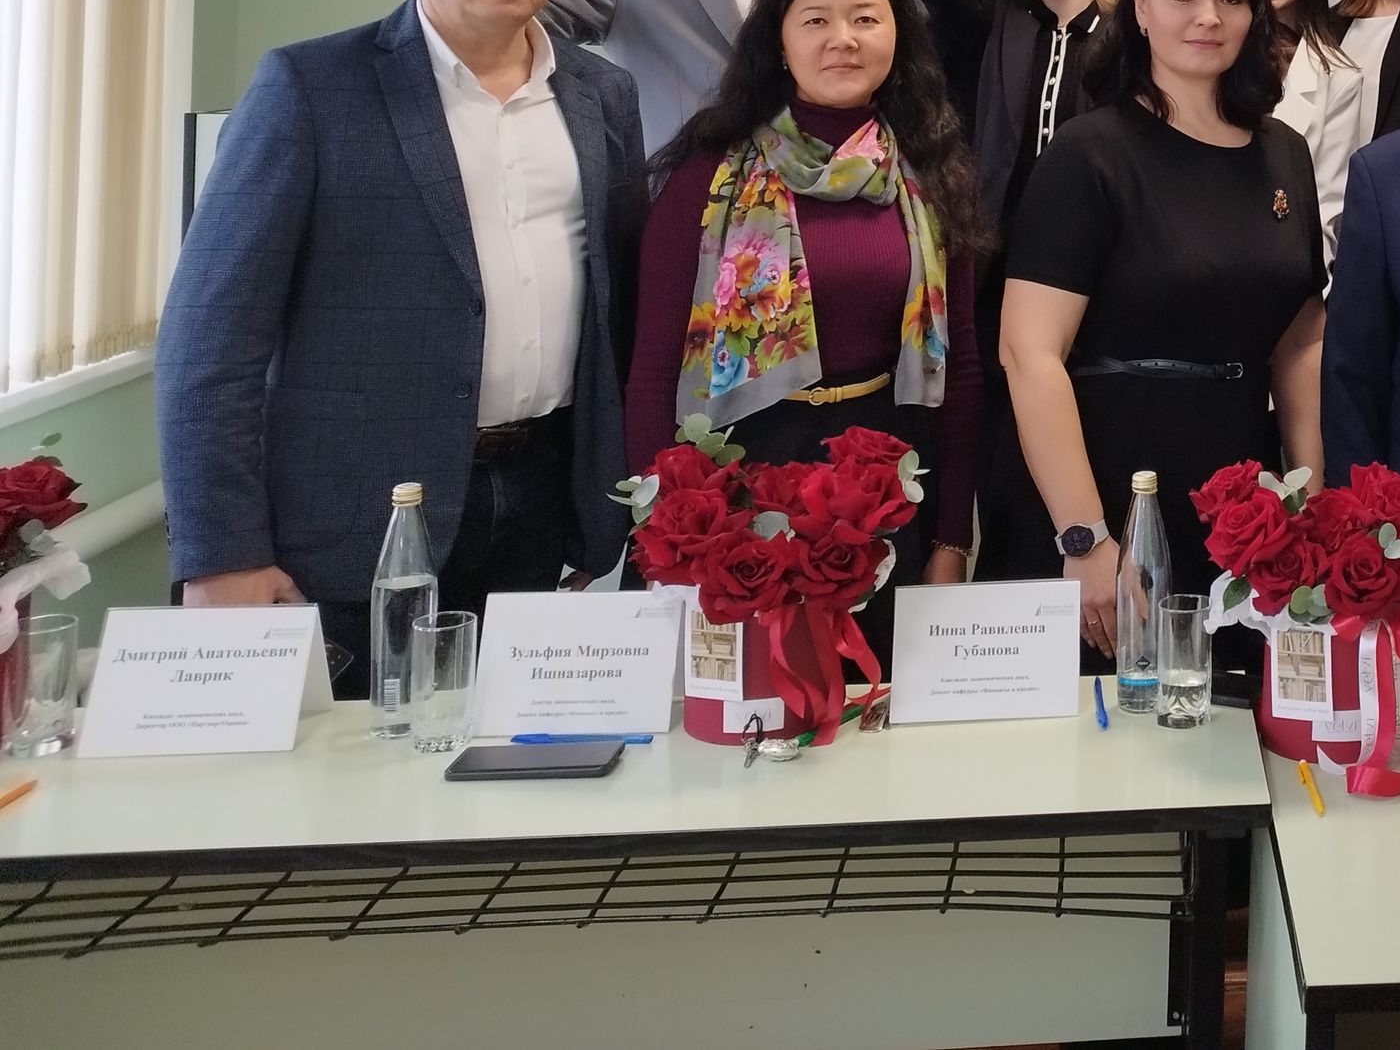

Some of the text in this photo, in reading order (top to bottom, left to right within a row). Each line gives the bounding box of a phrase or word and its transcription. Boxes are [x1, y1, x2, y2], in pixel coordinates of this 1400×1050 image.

[929, 623, 1046, 637] Инна Равилевна
[112, 647, 298, 663] Дмитрий Анатольевич
[509, 645, 650, 661] Зульфия Мирзовна
[953, 644, 1020, 660] Губанова
[170, 669, 234, 685] Лаврик
[531, 667, 623, 681] Ишназарова
